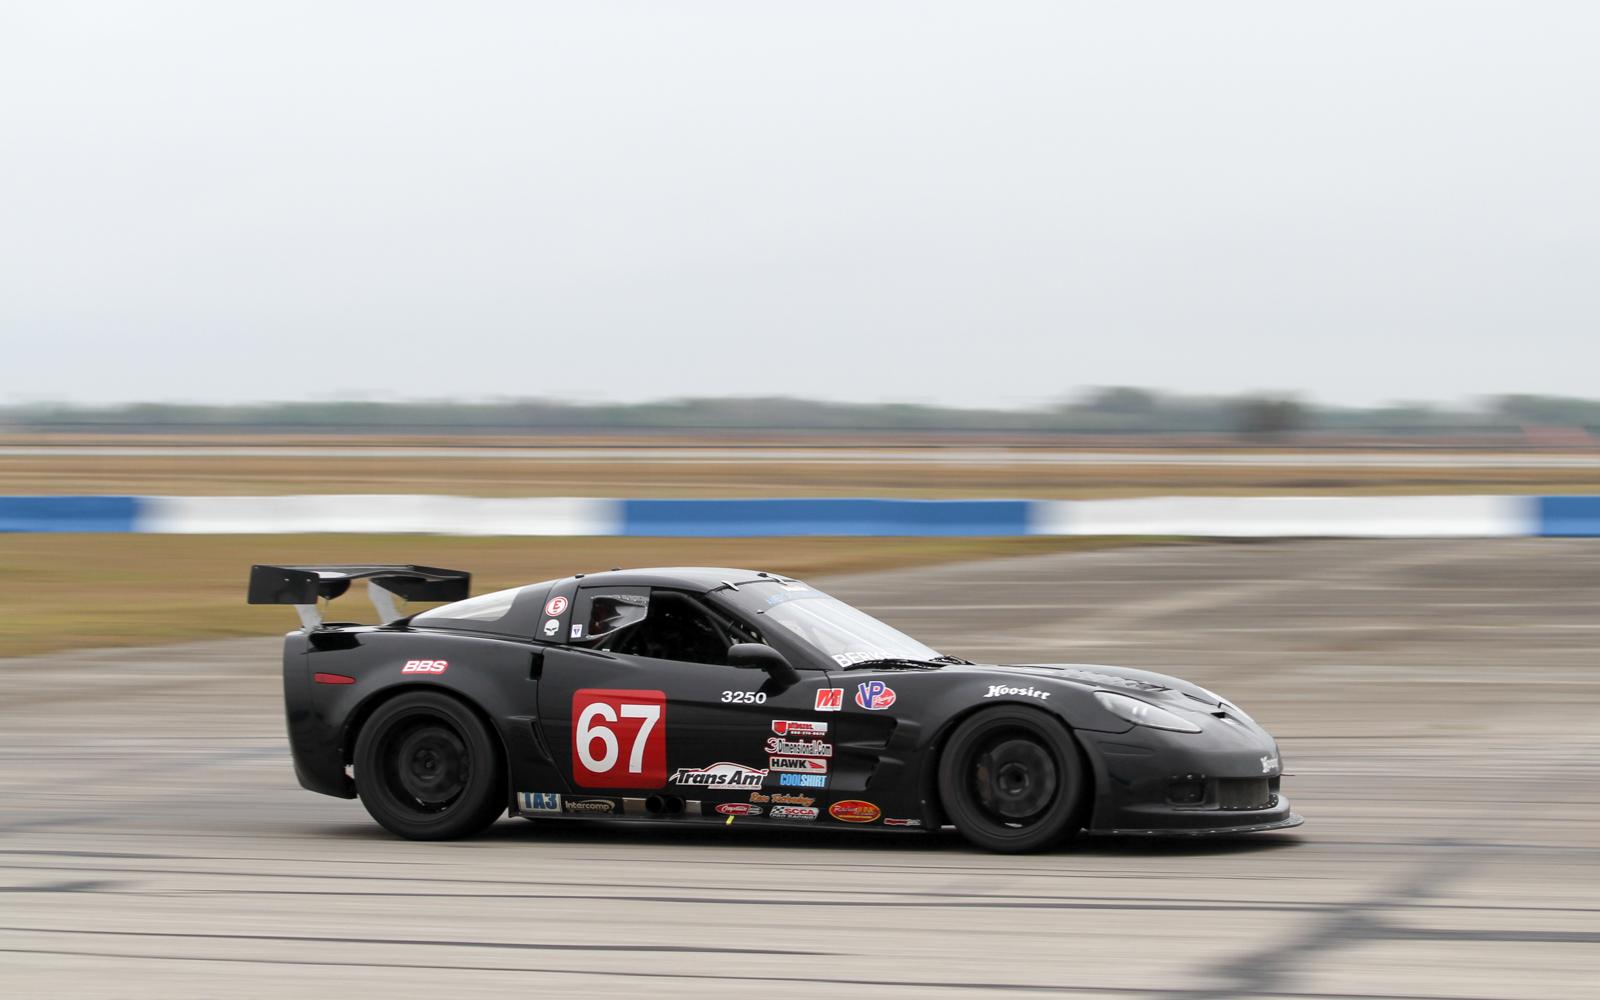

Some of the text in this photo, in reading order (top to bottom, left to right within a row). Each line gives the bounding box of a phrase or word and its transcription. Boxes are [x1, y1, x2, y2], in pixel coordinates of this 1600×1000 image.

[401, 660, 448, 673] BBS
[721, 690, 767, 704] 3250
[858, 681, 886, 710] VP
[576, 702, 661, 774] 67
[771, 758, 807, 769] HAWK
[677, 769, 763, 786] Trans Am
[565, 800, 610, 811] Intercomp
